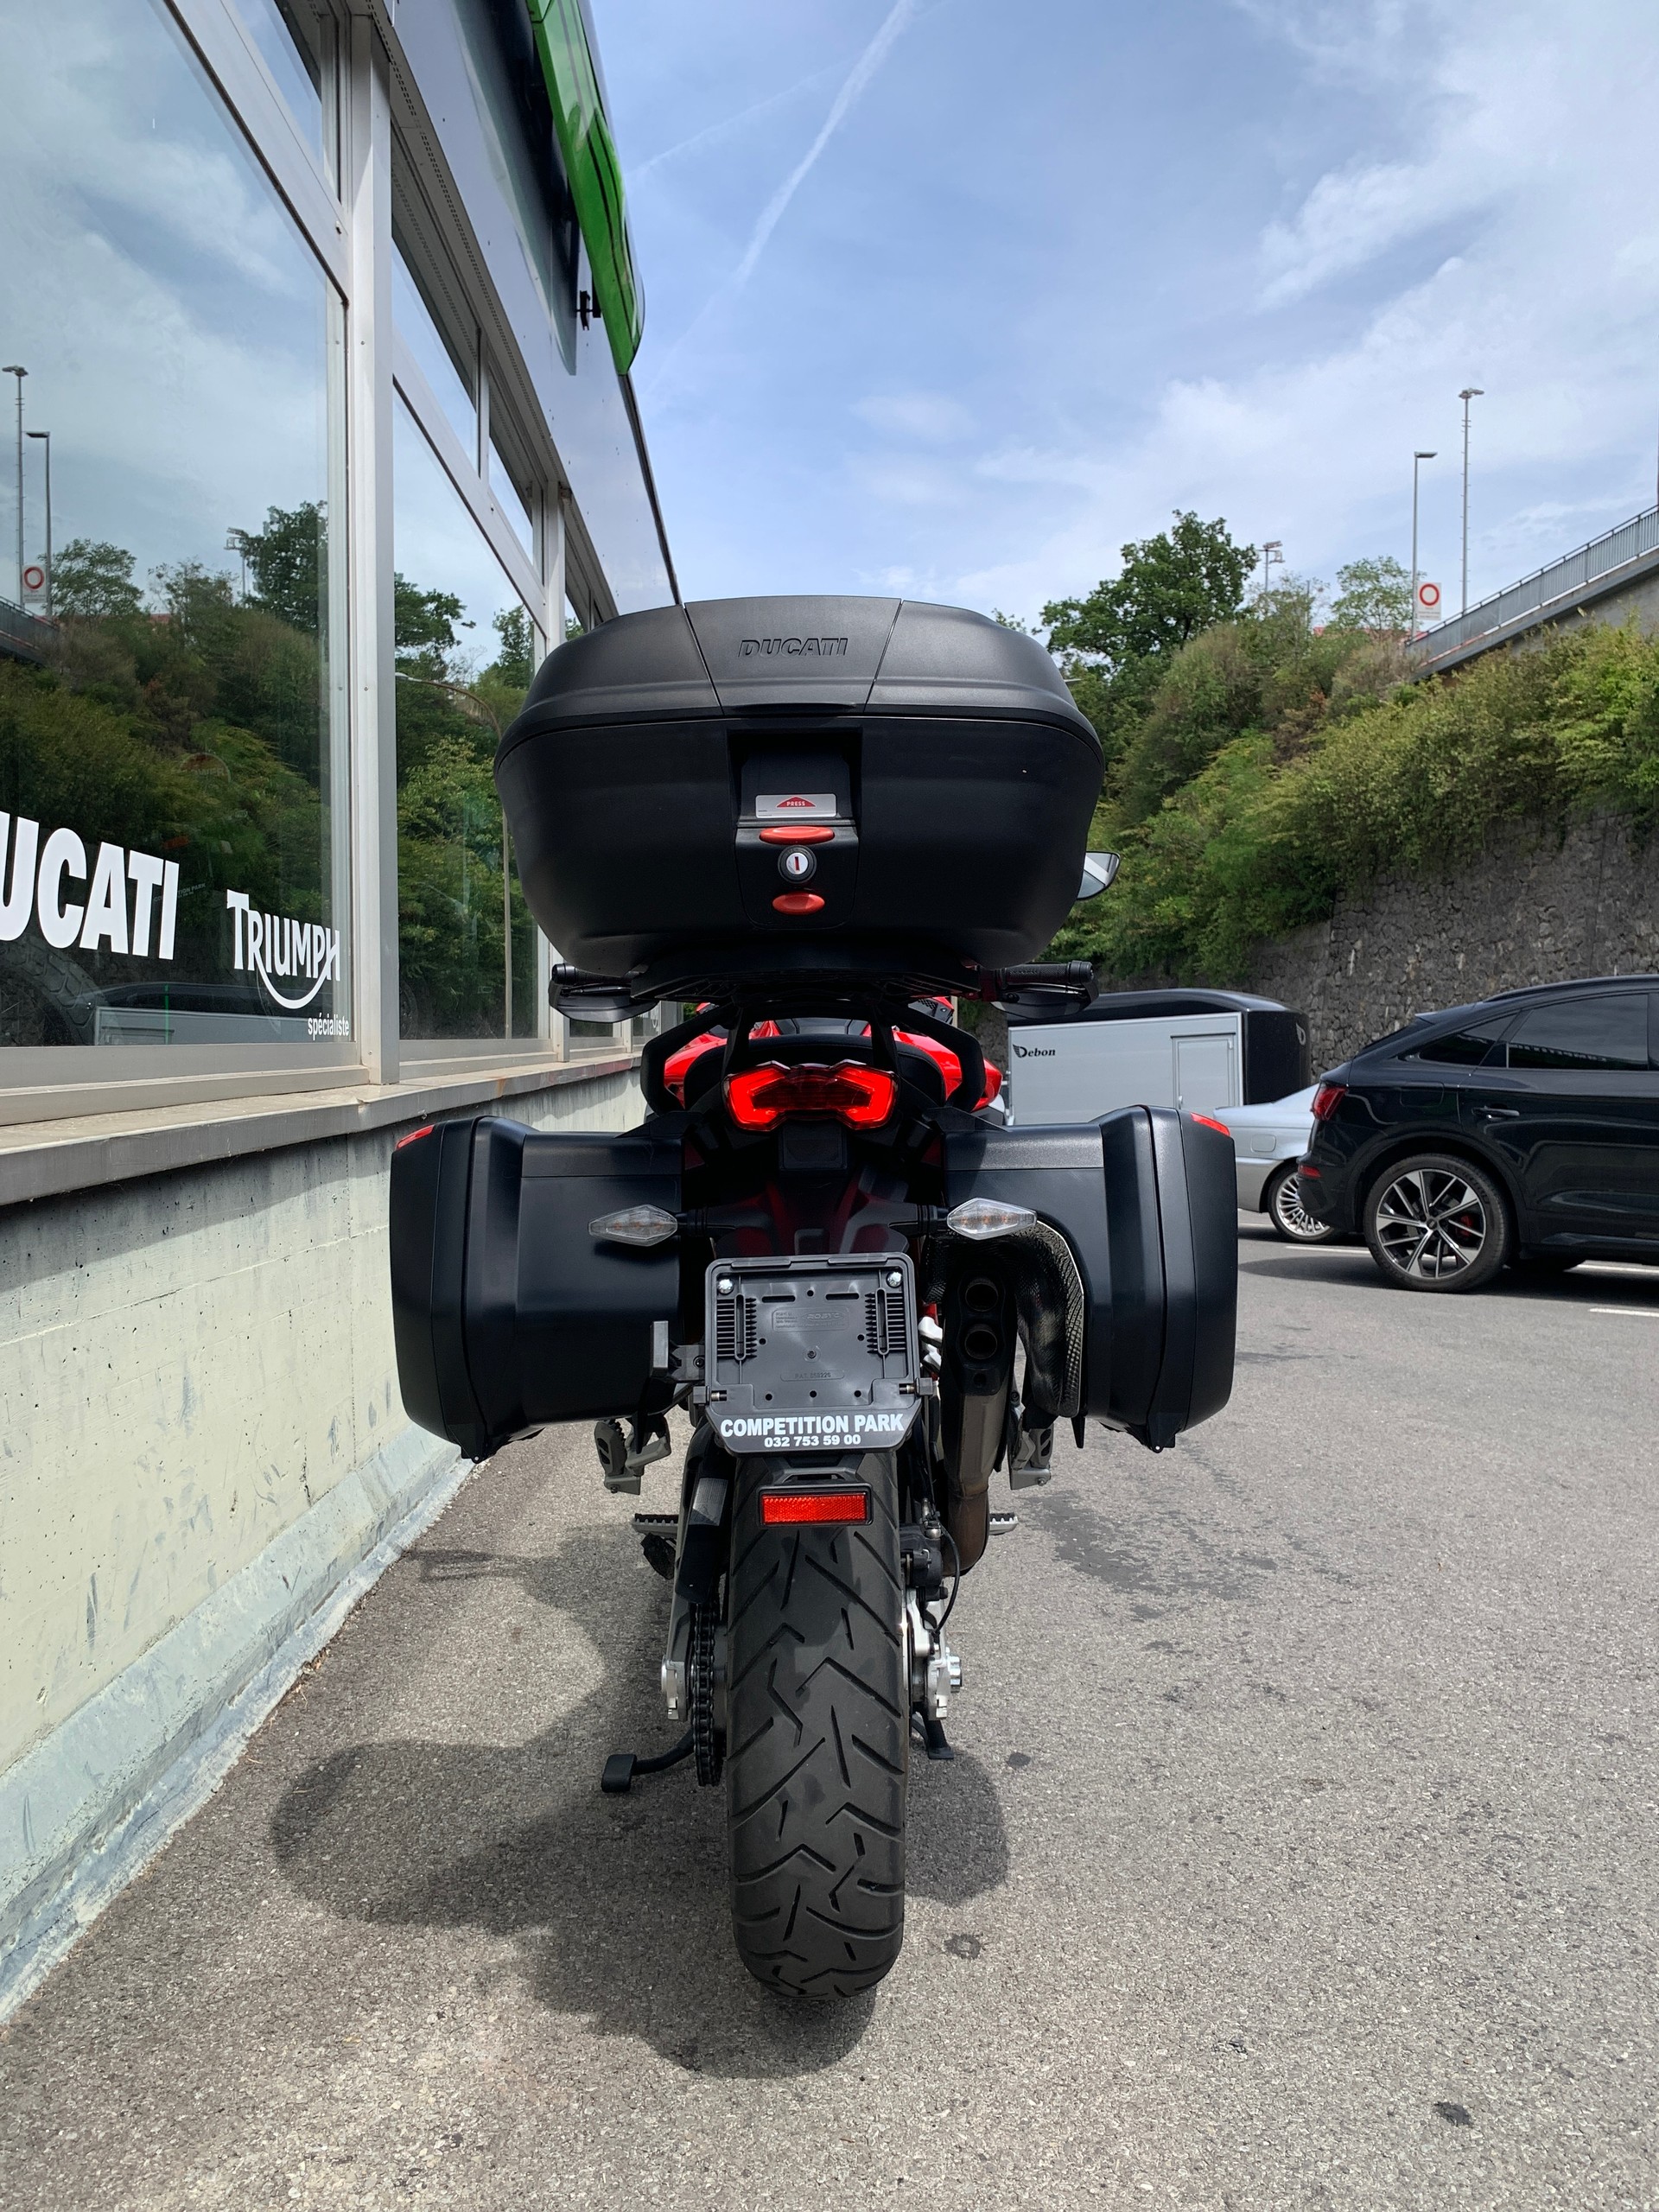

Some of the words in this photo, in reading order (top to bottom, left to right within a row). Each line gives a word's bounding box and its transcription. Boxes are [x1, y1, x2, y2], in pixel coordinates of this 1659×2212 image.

[738, 638, 849, 658] DUCATI
[226, 888, 340, 1009] TRIUMPH
[308, 1014, 350, 1040] spécialiste
[1013, 1044, 1056, 1058] Debon
[720, 1415, 849, 1438] COMPETITION
[855, 1413, 905, 1433] PARK
[764, 1436, 790, 1448] 032
[794, 1435, 820, 1446] 753
[823, 1433, 840, 1446] 59
[843, 1433, 861, 1446] 00
